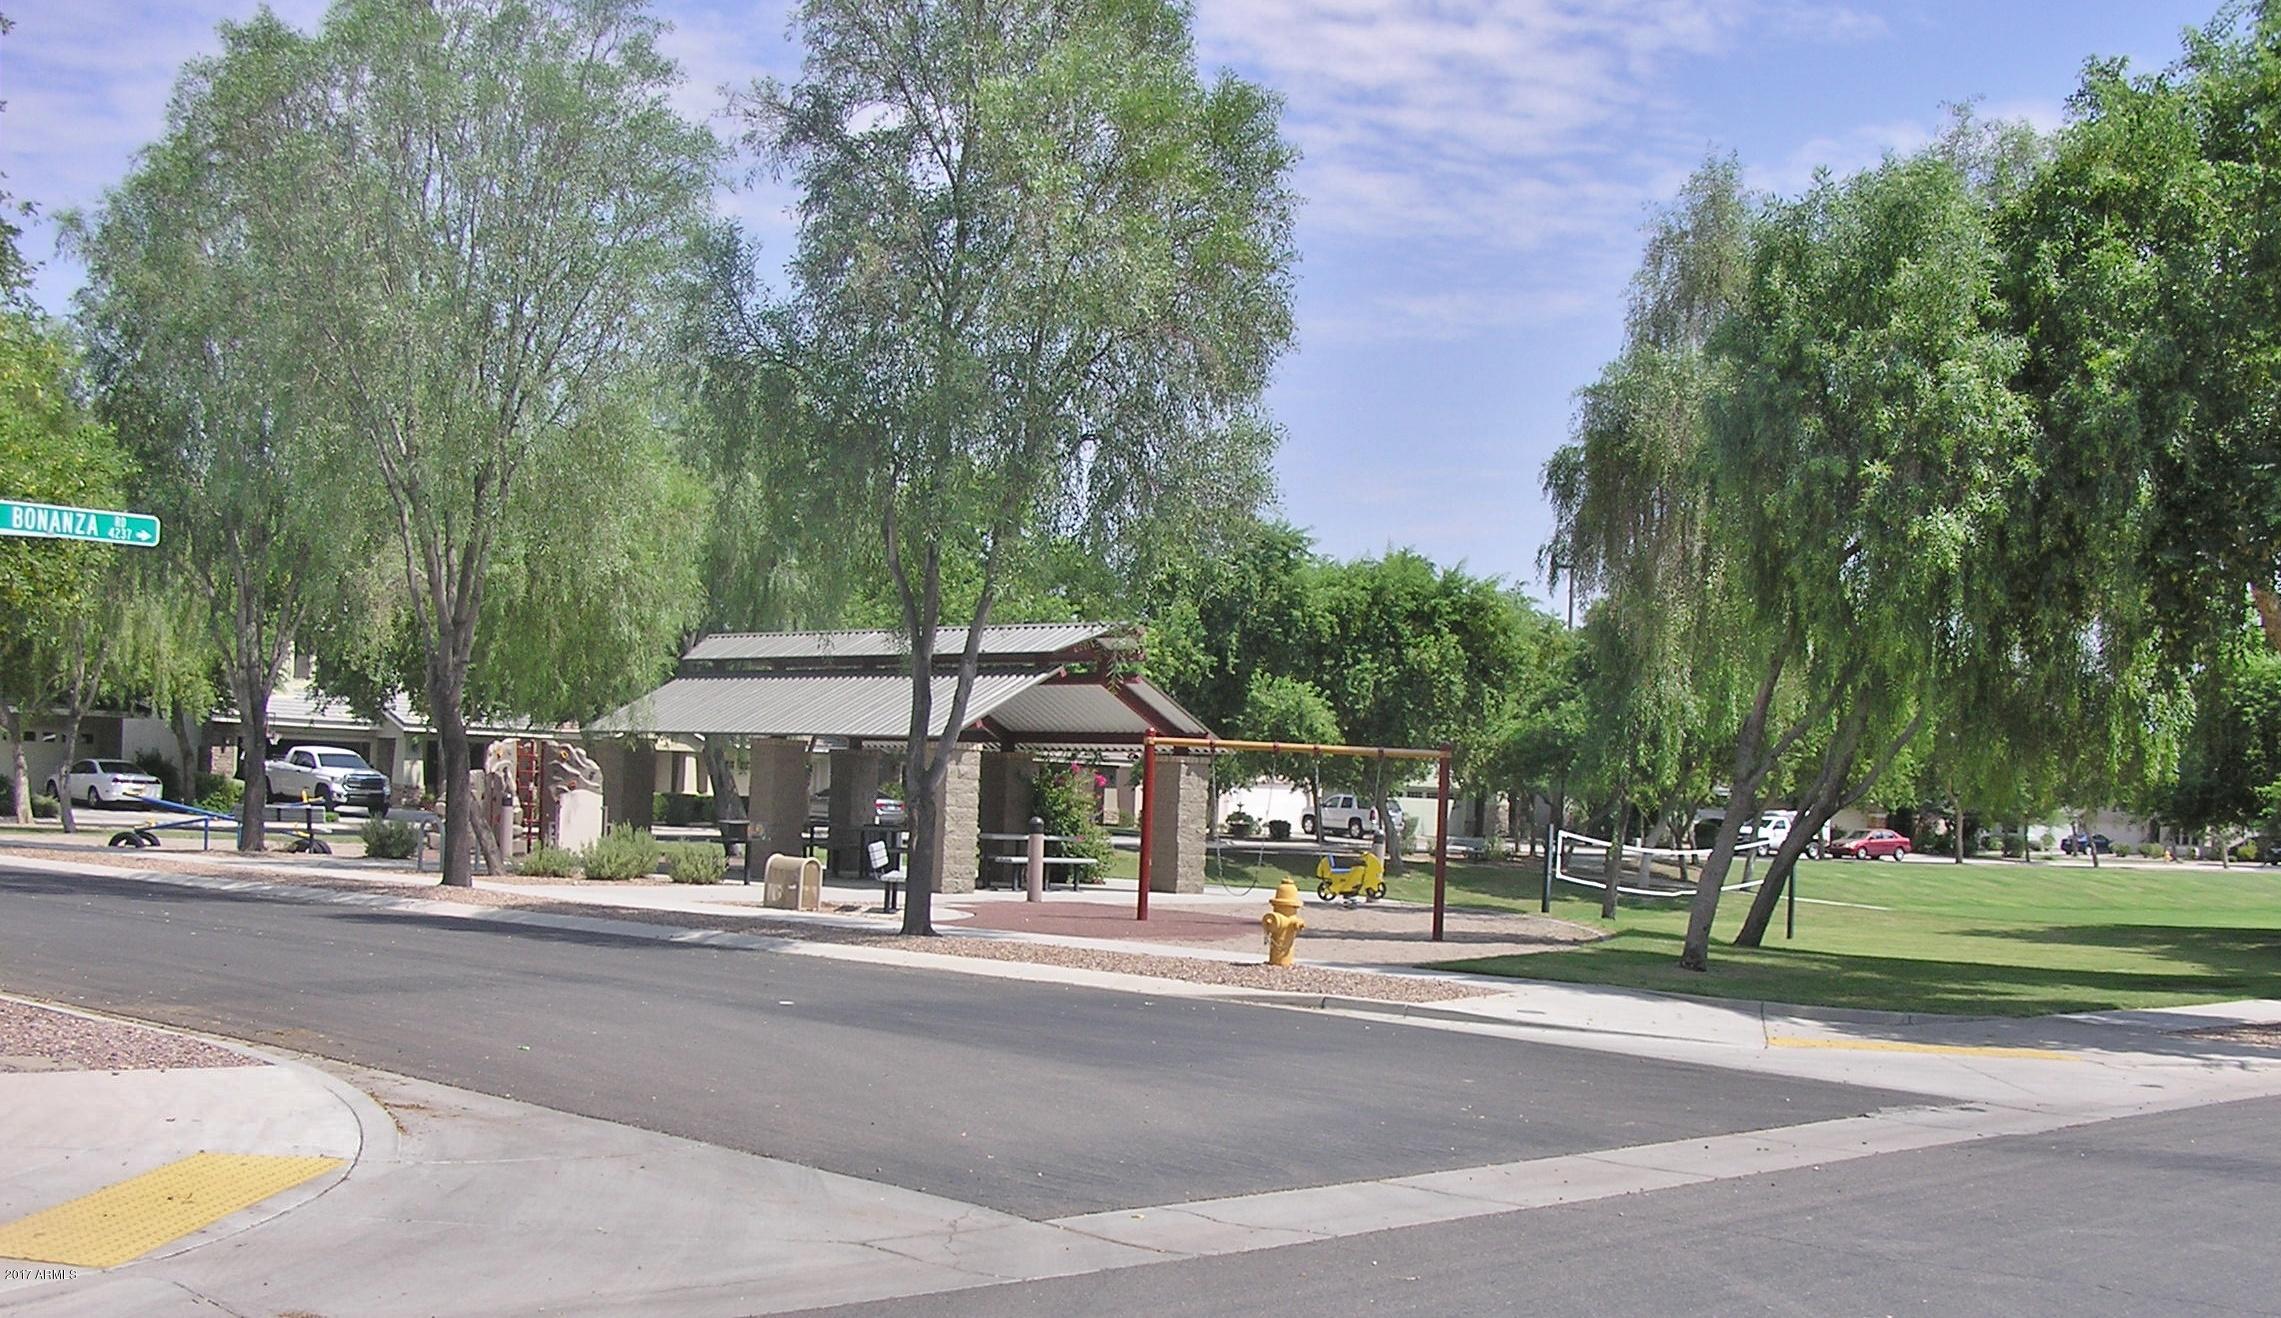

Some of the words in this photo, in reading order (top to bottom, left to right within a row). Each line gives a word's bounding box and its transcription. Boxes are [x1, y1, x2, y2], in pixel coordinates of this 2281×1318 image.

[12, 506, 99, 537] BONANZA
[114, 515, 127, 528] RD
[107, 527, 133, 540] 4237
